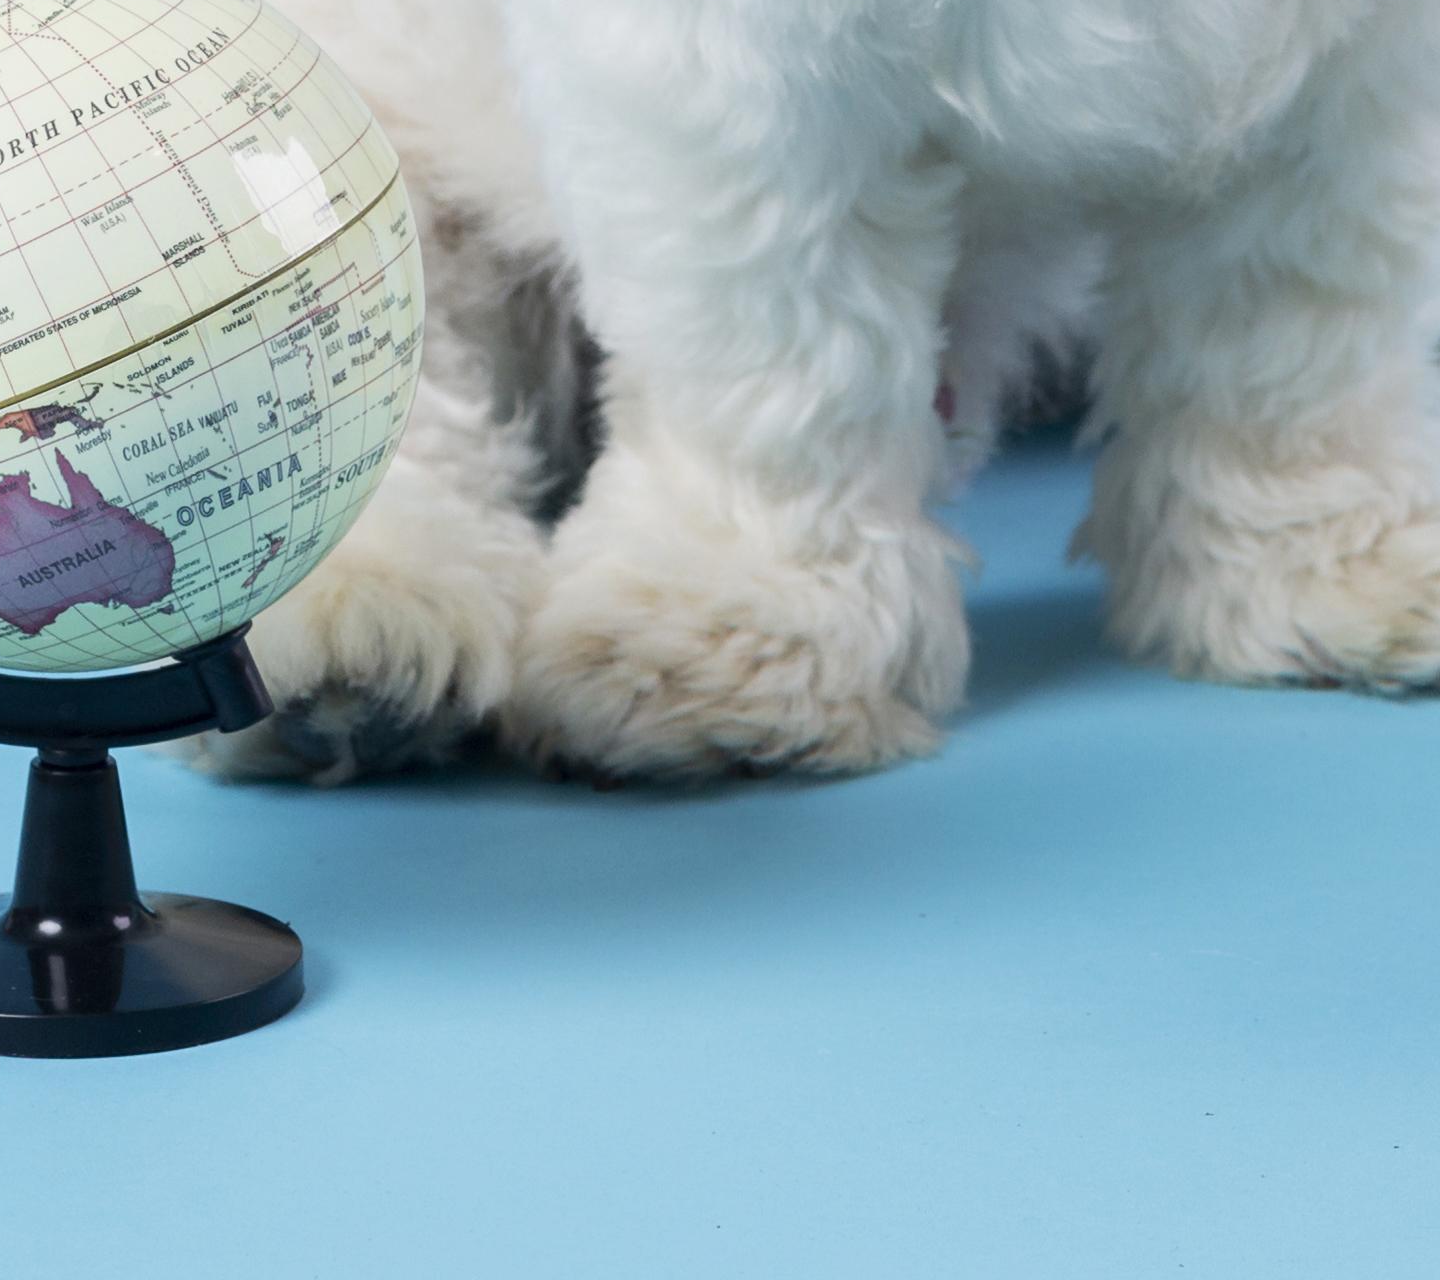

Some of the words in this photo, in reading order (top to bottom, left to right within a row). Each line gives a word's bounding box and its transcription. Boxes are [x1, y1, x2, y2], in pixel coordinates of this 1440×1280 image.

[70, 67, 172, 127] PACIFIC
[174, 26, 232, 74] OCEAN
[141, 100, 172, 119] Islands
[80, 208, 105, 227] Wake
[161, 232, 205, 261] MARSHALL
[172, 245, 206, 269] ISLANDS
[46, 315, 79, 336] STATES
[79, 309, 92, 322] OF
[91, 286, 143, 316] MICRONESIA
[230, 289, 270, 316] KIRIBATI
[162, 329, 190, 347] NAURU
[220, 312, 253, 335] TUVALU
[126, 354, 173, 383] SOLOMON
[155, 356, 196, 385] ISLANDS
[197, 399, 240, 429] VANUATU
[257, 389, 274, 410] FIJI
[286, 389, 317, 414] TONGA
[74, 428, 113, 455] Moresby
[122, 432, 167, 462] CORAL
[168, 417, 195, 440] SEA
[144, 469, 167, 487] New
[167, 446, 211, 479] Caledonia
[333, 444, 388, 491] SOUTH
[175, 451, 304, 528] OCEANIA
[16, 538, 118, 590] AUSTRALIA
[218, 558, 241, 574] NEW
